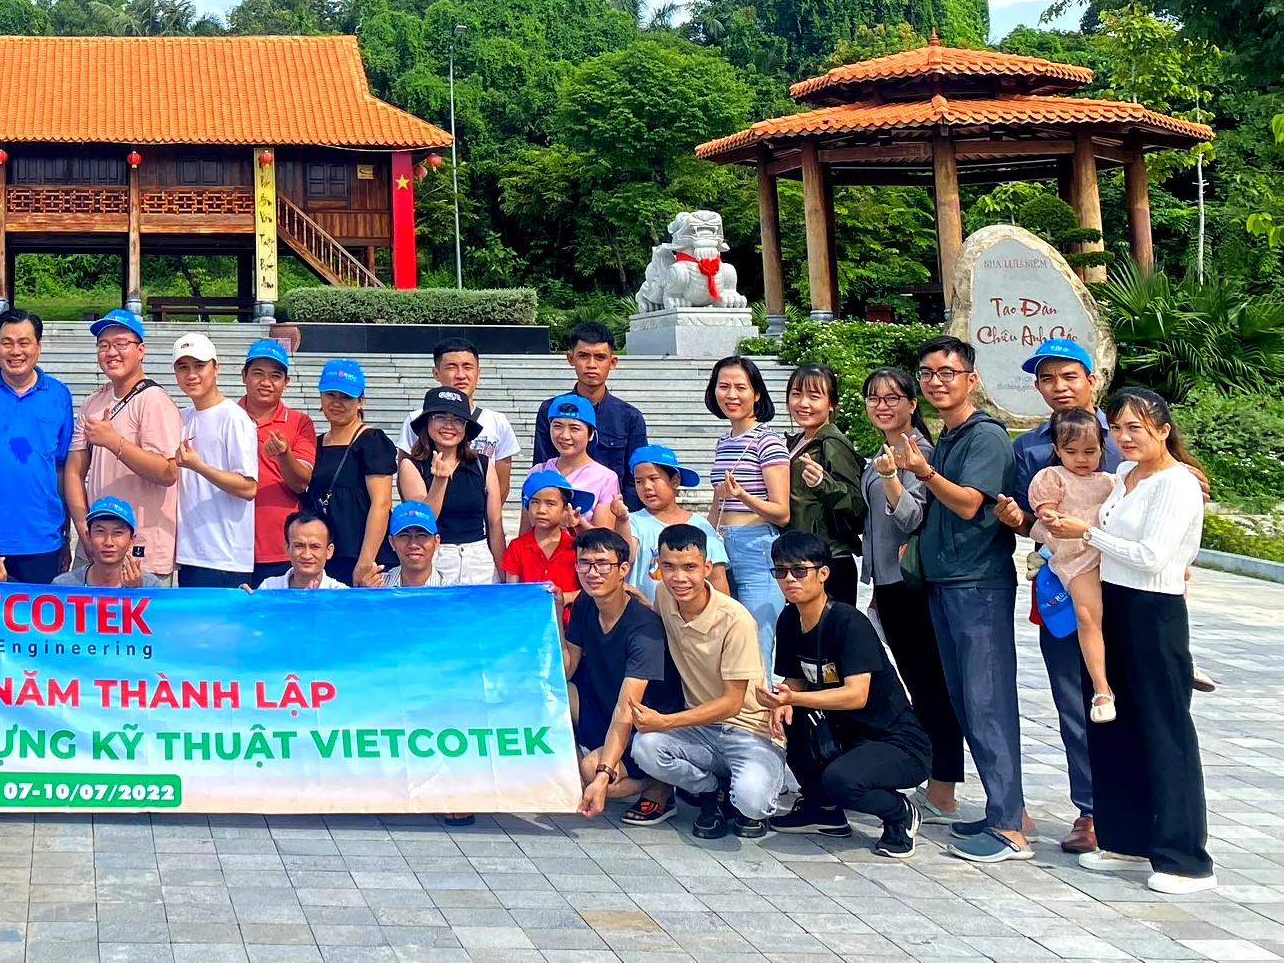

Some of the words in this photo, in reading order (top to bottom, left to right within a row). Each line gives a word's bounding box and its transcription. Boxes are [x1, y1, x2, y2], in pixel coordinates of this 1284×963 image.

[990, 297, 1016, 317] Tao
[1019, 297, 1058, 317] Đàn
[977, 325, 1018, 344] Chiêu
[1021, 325, 1047, 346] Anh
[93, 672, 240, 709] THÀNH
[255, 673, 336, 717] LẬP
[91, 723, 145, 761] KỸ
[156, 723, 298, 768] THUẬT
[310, 726, 556, 758] VIETCOTEK
[3, 782, 176, 802] 07-10/07/2022
